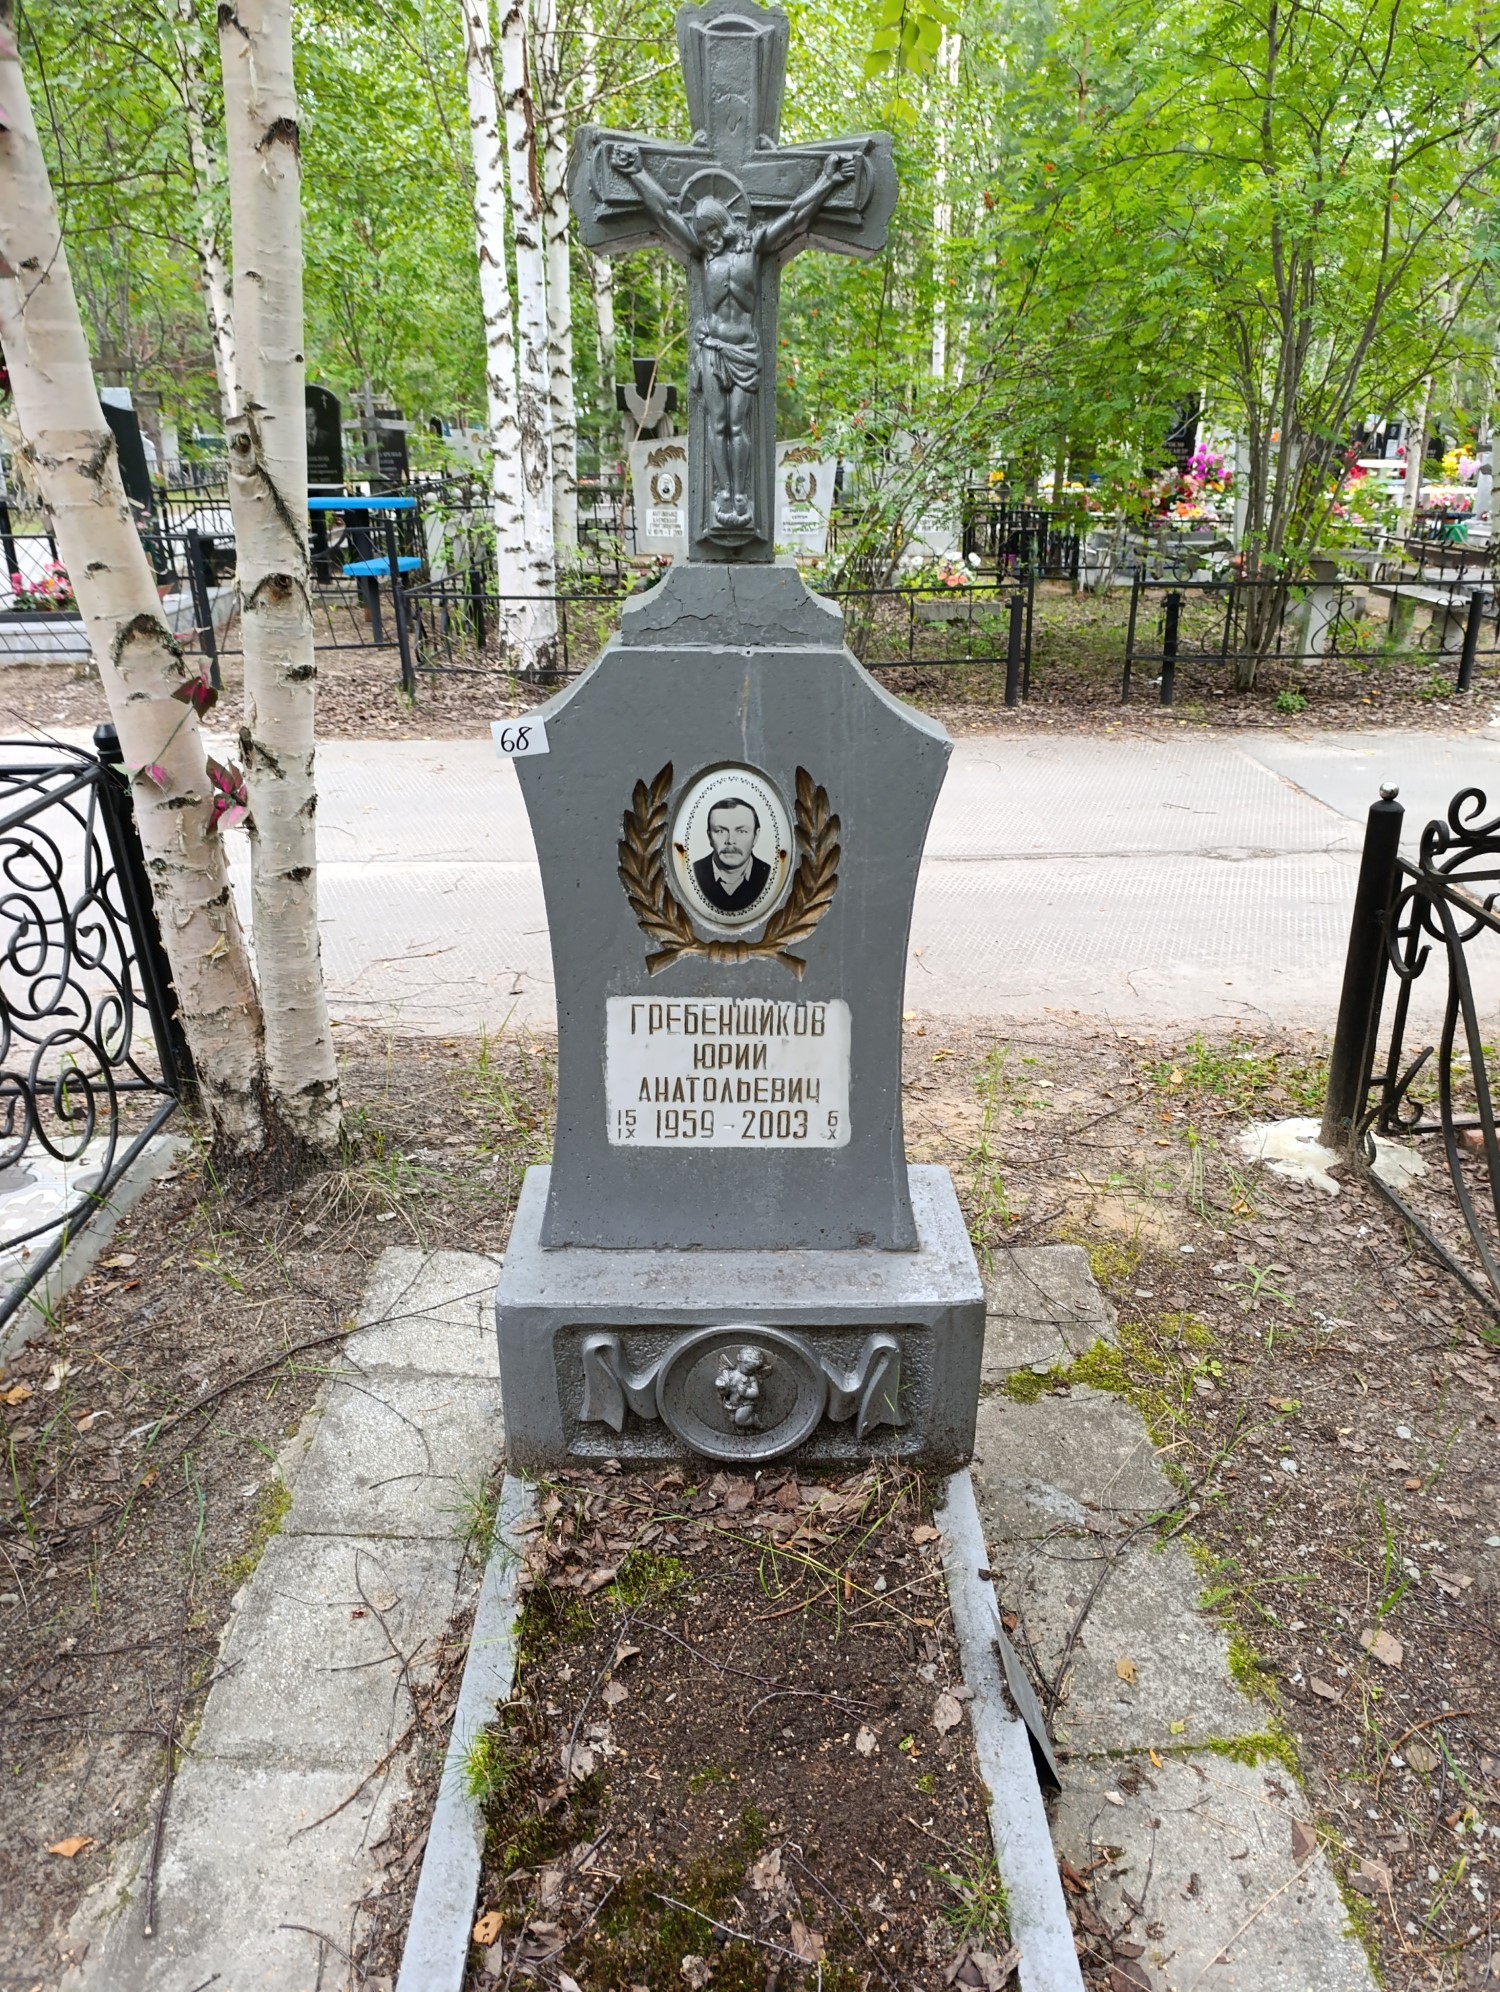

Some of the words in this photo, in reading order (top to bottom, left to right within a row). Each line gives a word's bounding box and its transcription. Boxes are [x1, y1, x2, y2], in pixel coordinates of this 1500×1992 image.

[501, 726, 533, 752] 68
[631, 1004, 826, 1036] ГРЕБЕНЩИКОВ
[693, 1040, 768, 1070] ЮРИЙ
[638, 1076, 821, 1104] АНАТОЛЬЕВИЧ
[618, 1110, 636, 1125] 15
[827, 1110, 839, 1126] 6
